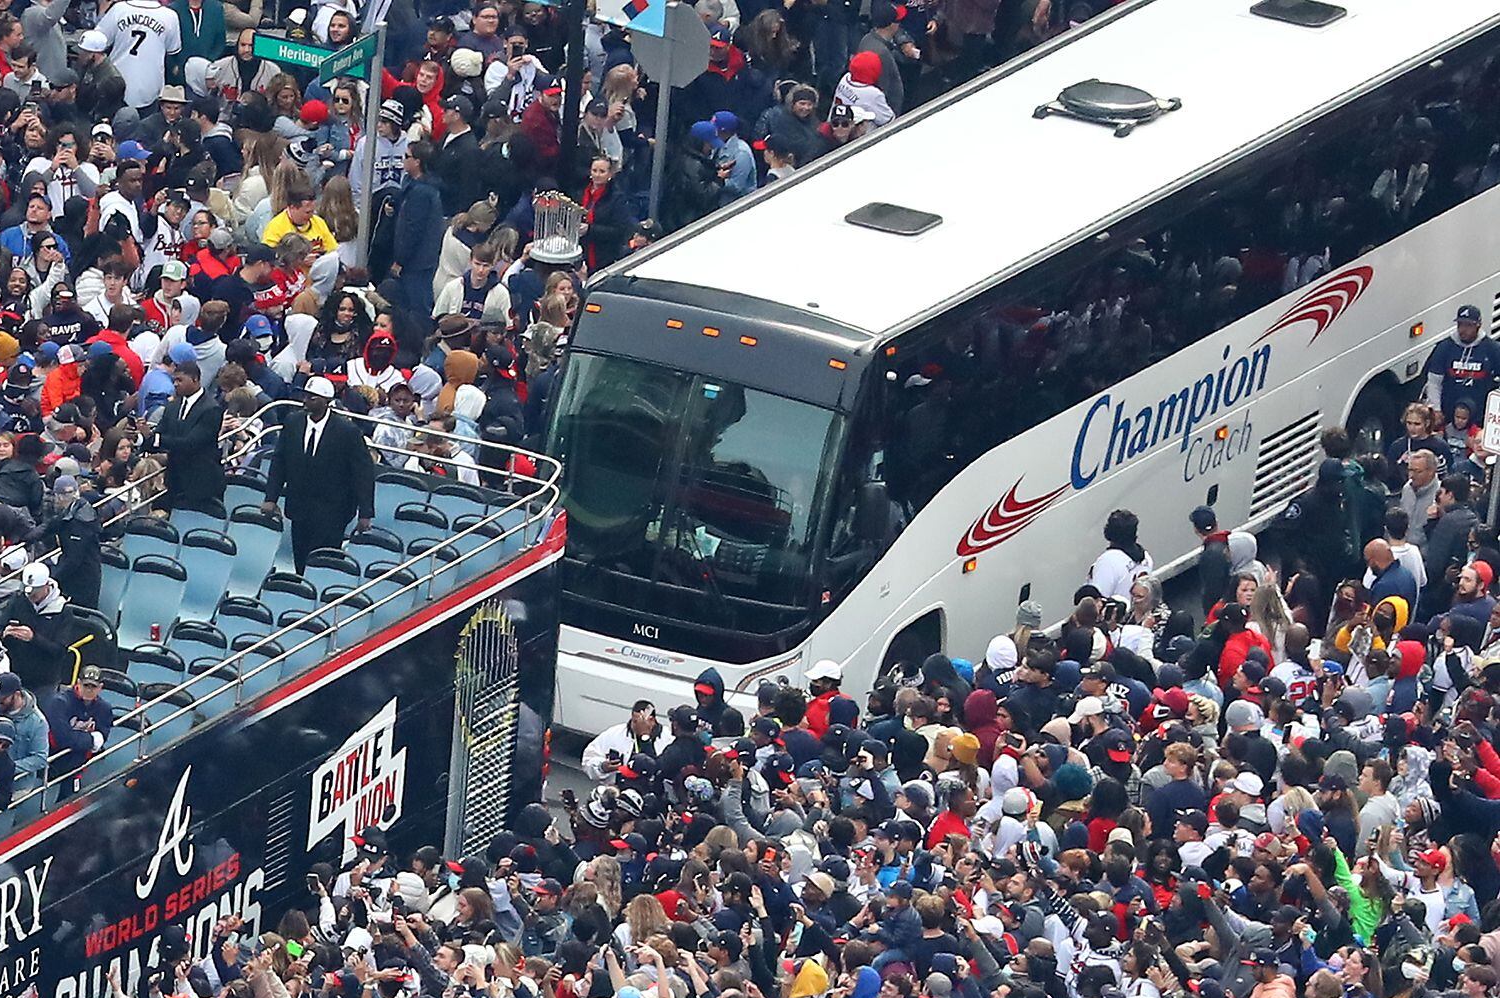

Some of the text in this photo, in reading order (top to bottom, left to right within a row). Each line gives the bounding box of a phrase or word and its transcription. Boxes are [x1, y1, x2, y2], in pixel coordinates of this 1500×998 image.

[117, 14, 165, 37] FRANCOEUR
[129, 30, 147, 56] 7
[279, 44, 324, 68] Heritage
[49, 323, 81, 335] RAVES
[1452, 360, 1483, 372] BRAVES
[1070, 344, 1271, 490] Champion
[1184, 409, 1252, 482] Coach
[632, 623, 659, 640] MCI
[621, 645, 671, 666] Champion
[318, 727, 387, 823] BATTLE
[354, 769, 398, 835] WON
[85, 852, 241, 958] WORLD SERIES
